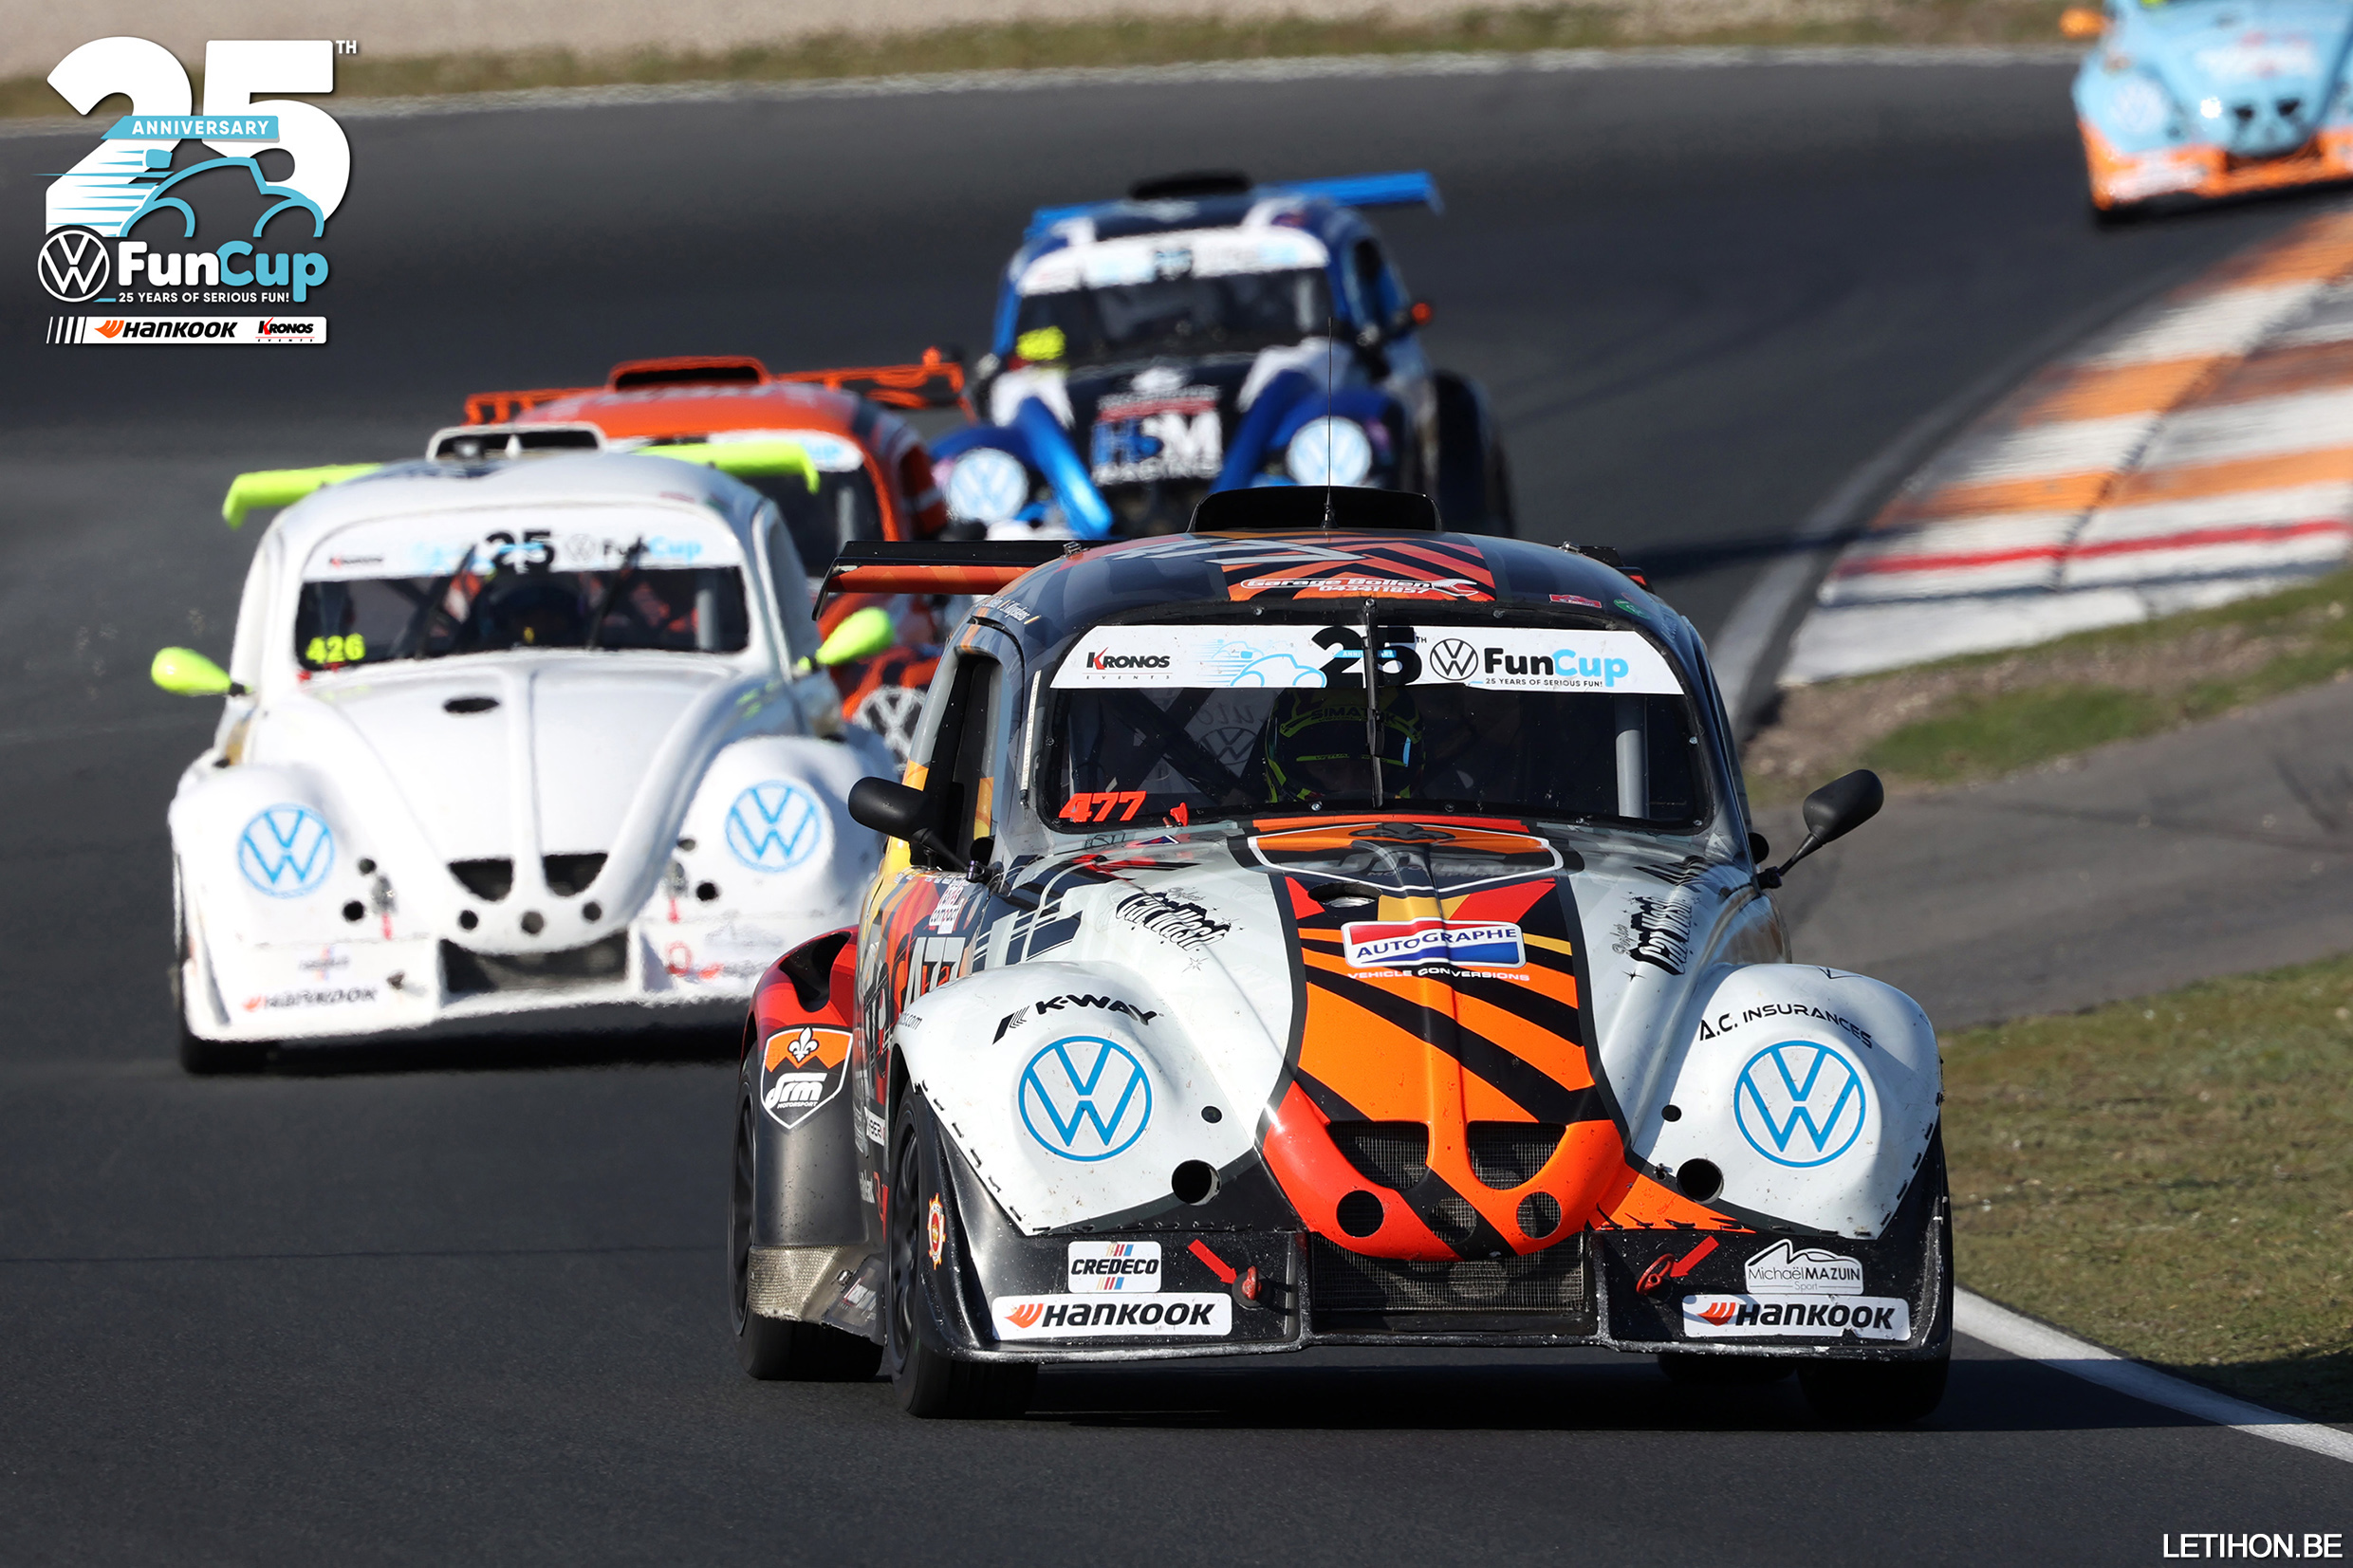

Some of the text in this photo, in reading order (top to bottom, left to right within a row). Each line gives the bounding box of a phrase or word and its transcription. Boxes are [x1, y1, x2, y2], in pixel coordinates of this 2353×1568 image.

[486, 530, 554, 570] 25
[306, 633, 365, 664] 426
[1086, 647, 1170, 670] KRONOS
[1484, 647, 1629, 687] FunCup
[1059, 791, 1146, 822] 477
[1116, 892, 1228, 951] Car Wash
[1632, 896, 1692, 975] Car Wash
[1357, 929, 1517, 958] AUTOGRAPHE
[1347, 968, 1529, 981] VEHICLE CONVERSIONS
[1699, 1004, 1873, 1048] A.C. INSURANCES
[777, 1100, 818, 1110] MOTORSPORT
[1071, 1259, 1158, 1275] CREDECO
[1794, 1281, 1818, 1291] Sport
